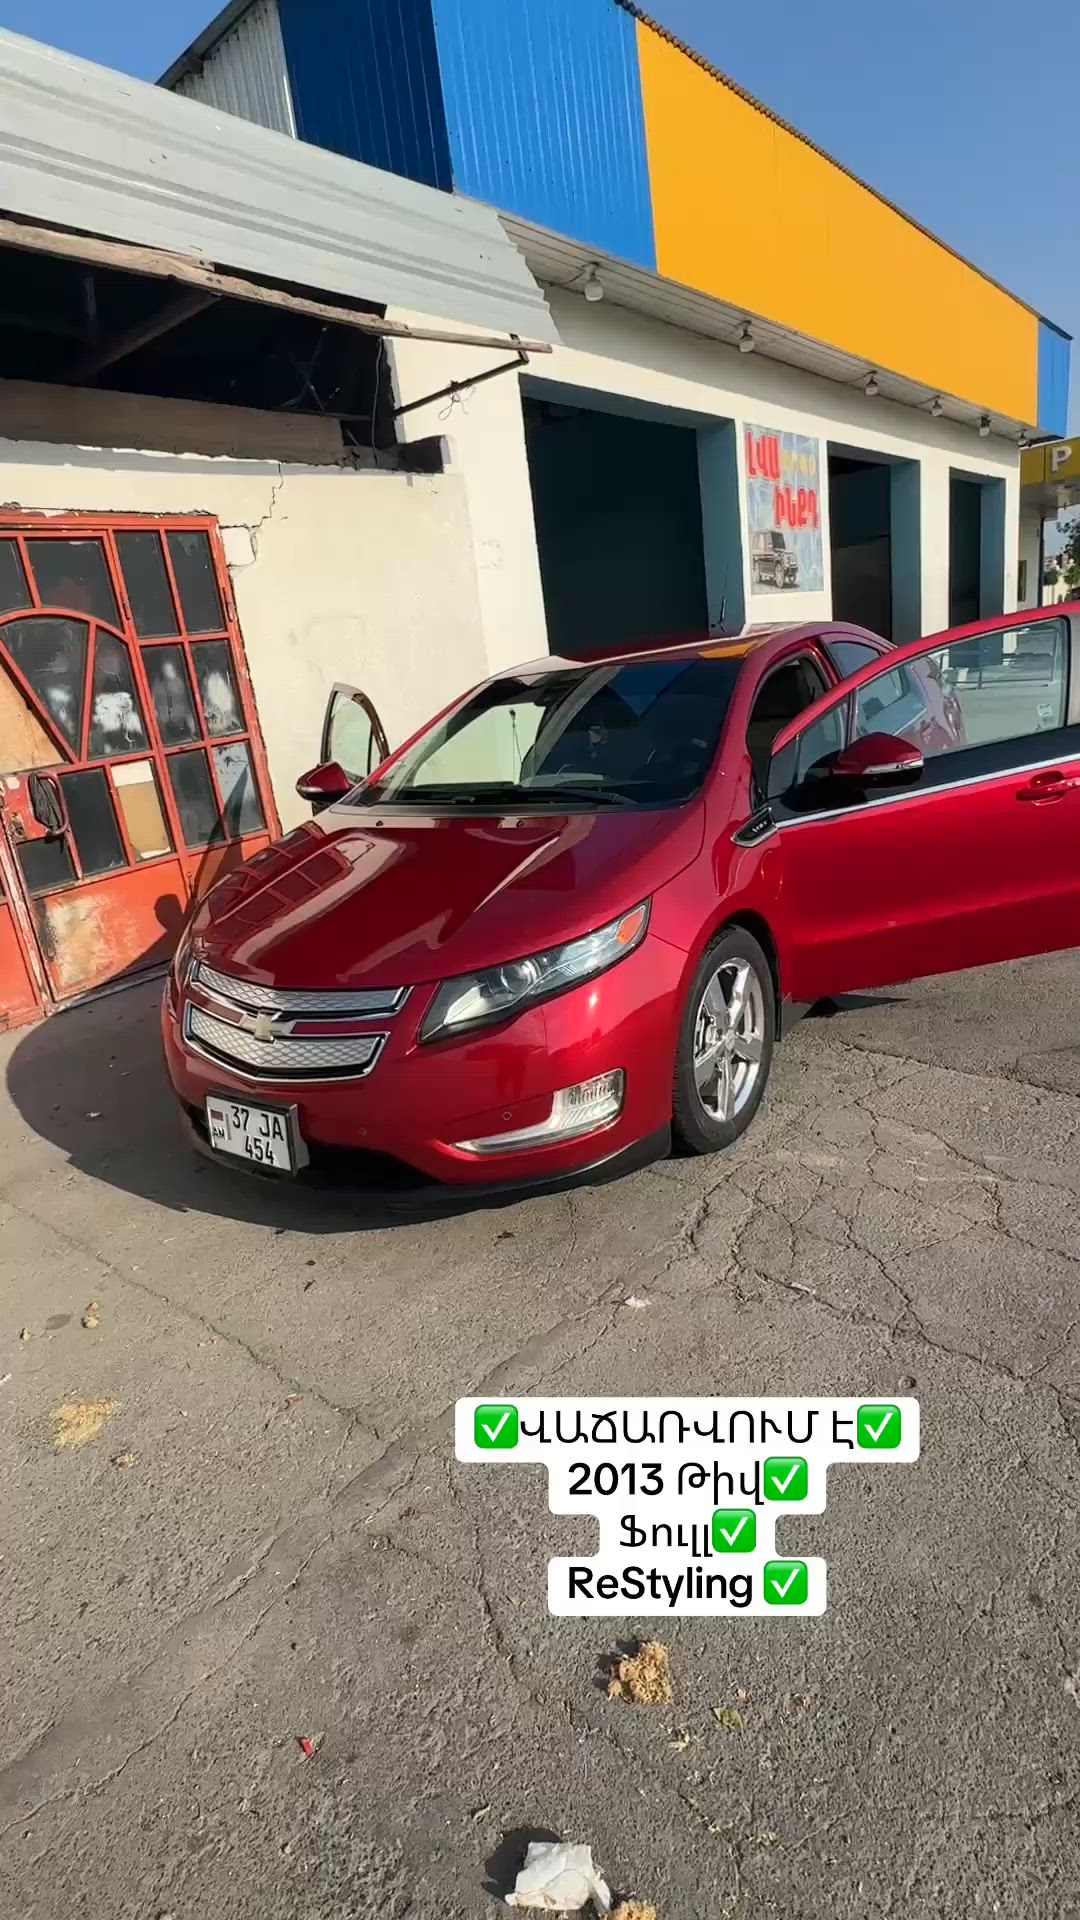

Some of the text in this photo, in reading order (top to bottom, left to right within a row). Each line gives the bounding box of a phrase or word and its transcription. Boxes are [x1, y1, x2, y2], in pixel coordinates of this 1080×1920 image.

[1051, 446, 1072, 472] P
[231, 1105, 284, 1141] 37 JA
[245, 1135, 274, 1164] 454
